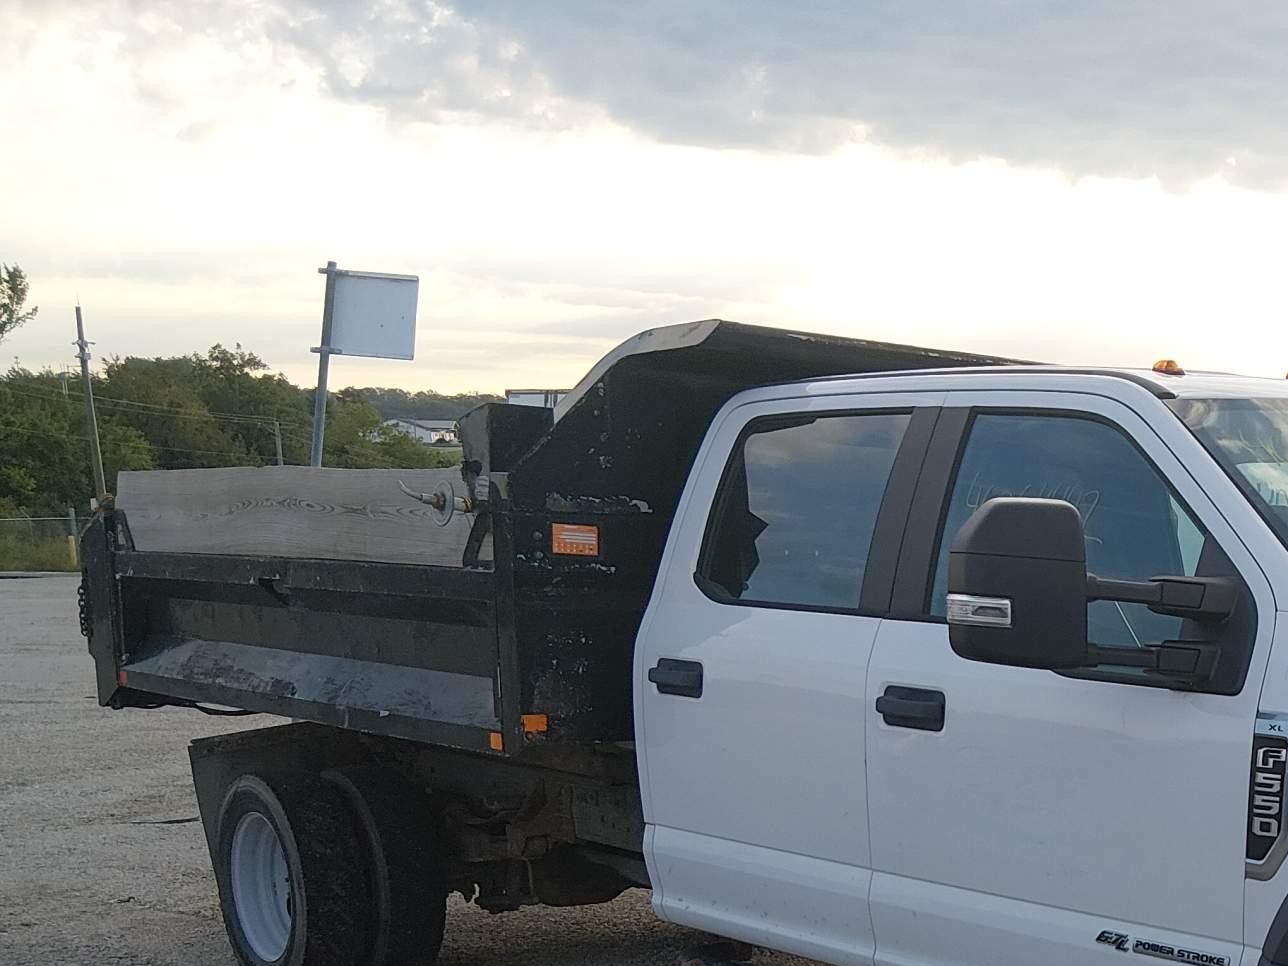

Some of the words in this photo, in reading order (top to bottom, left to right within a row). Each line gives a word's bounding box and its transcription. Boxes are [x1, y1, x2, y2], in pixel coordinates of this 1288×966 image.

[1268, 724, 1284, 732] XL
[1251, 747, 1287, 837] F550
[1134, 940, 1175, 957] POWER
[1176, 949, 1225, 966] STROKE
